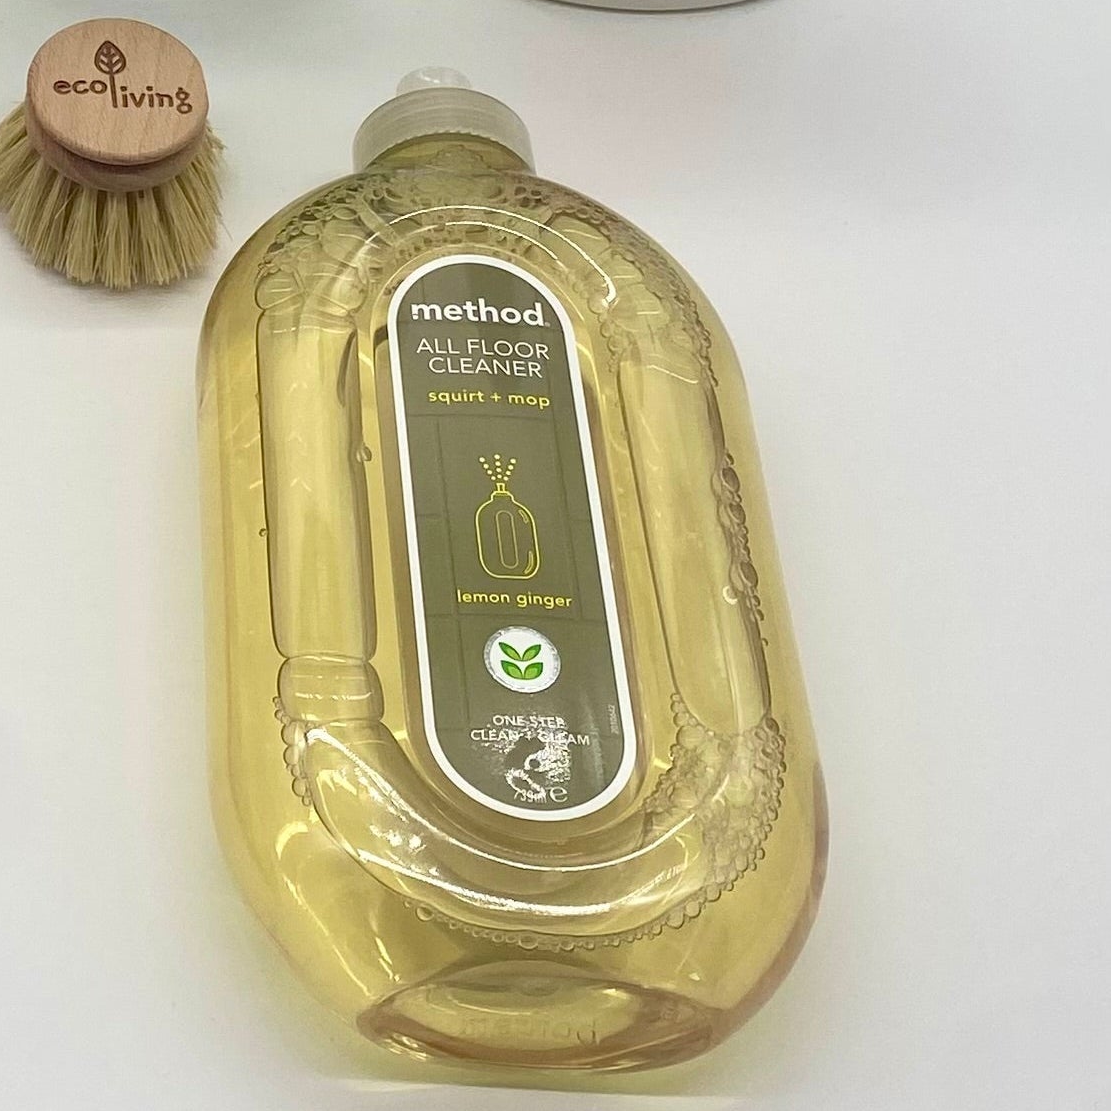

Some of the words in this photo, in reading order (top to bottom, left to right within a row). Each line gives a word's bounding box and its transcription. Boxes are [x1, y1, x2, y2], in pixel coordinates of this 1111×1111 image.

[411, 297, 545, 327] method
[417, 338, 460, 354] ALL
[467, 339, 550, 360] FLOOR
[428, 357, 543, 378] CLEANER
[428, 390, 484, 406] squirt
[490, 393, 502, 403] +
[508, 395, 551, 410] mop
[457, 589, 510, 604] lemon
[516, 591, 572, 609] ginger
[492, 715, 524, 726] ONE
[471, 729, 519, 742] CLEAN
